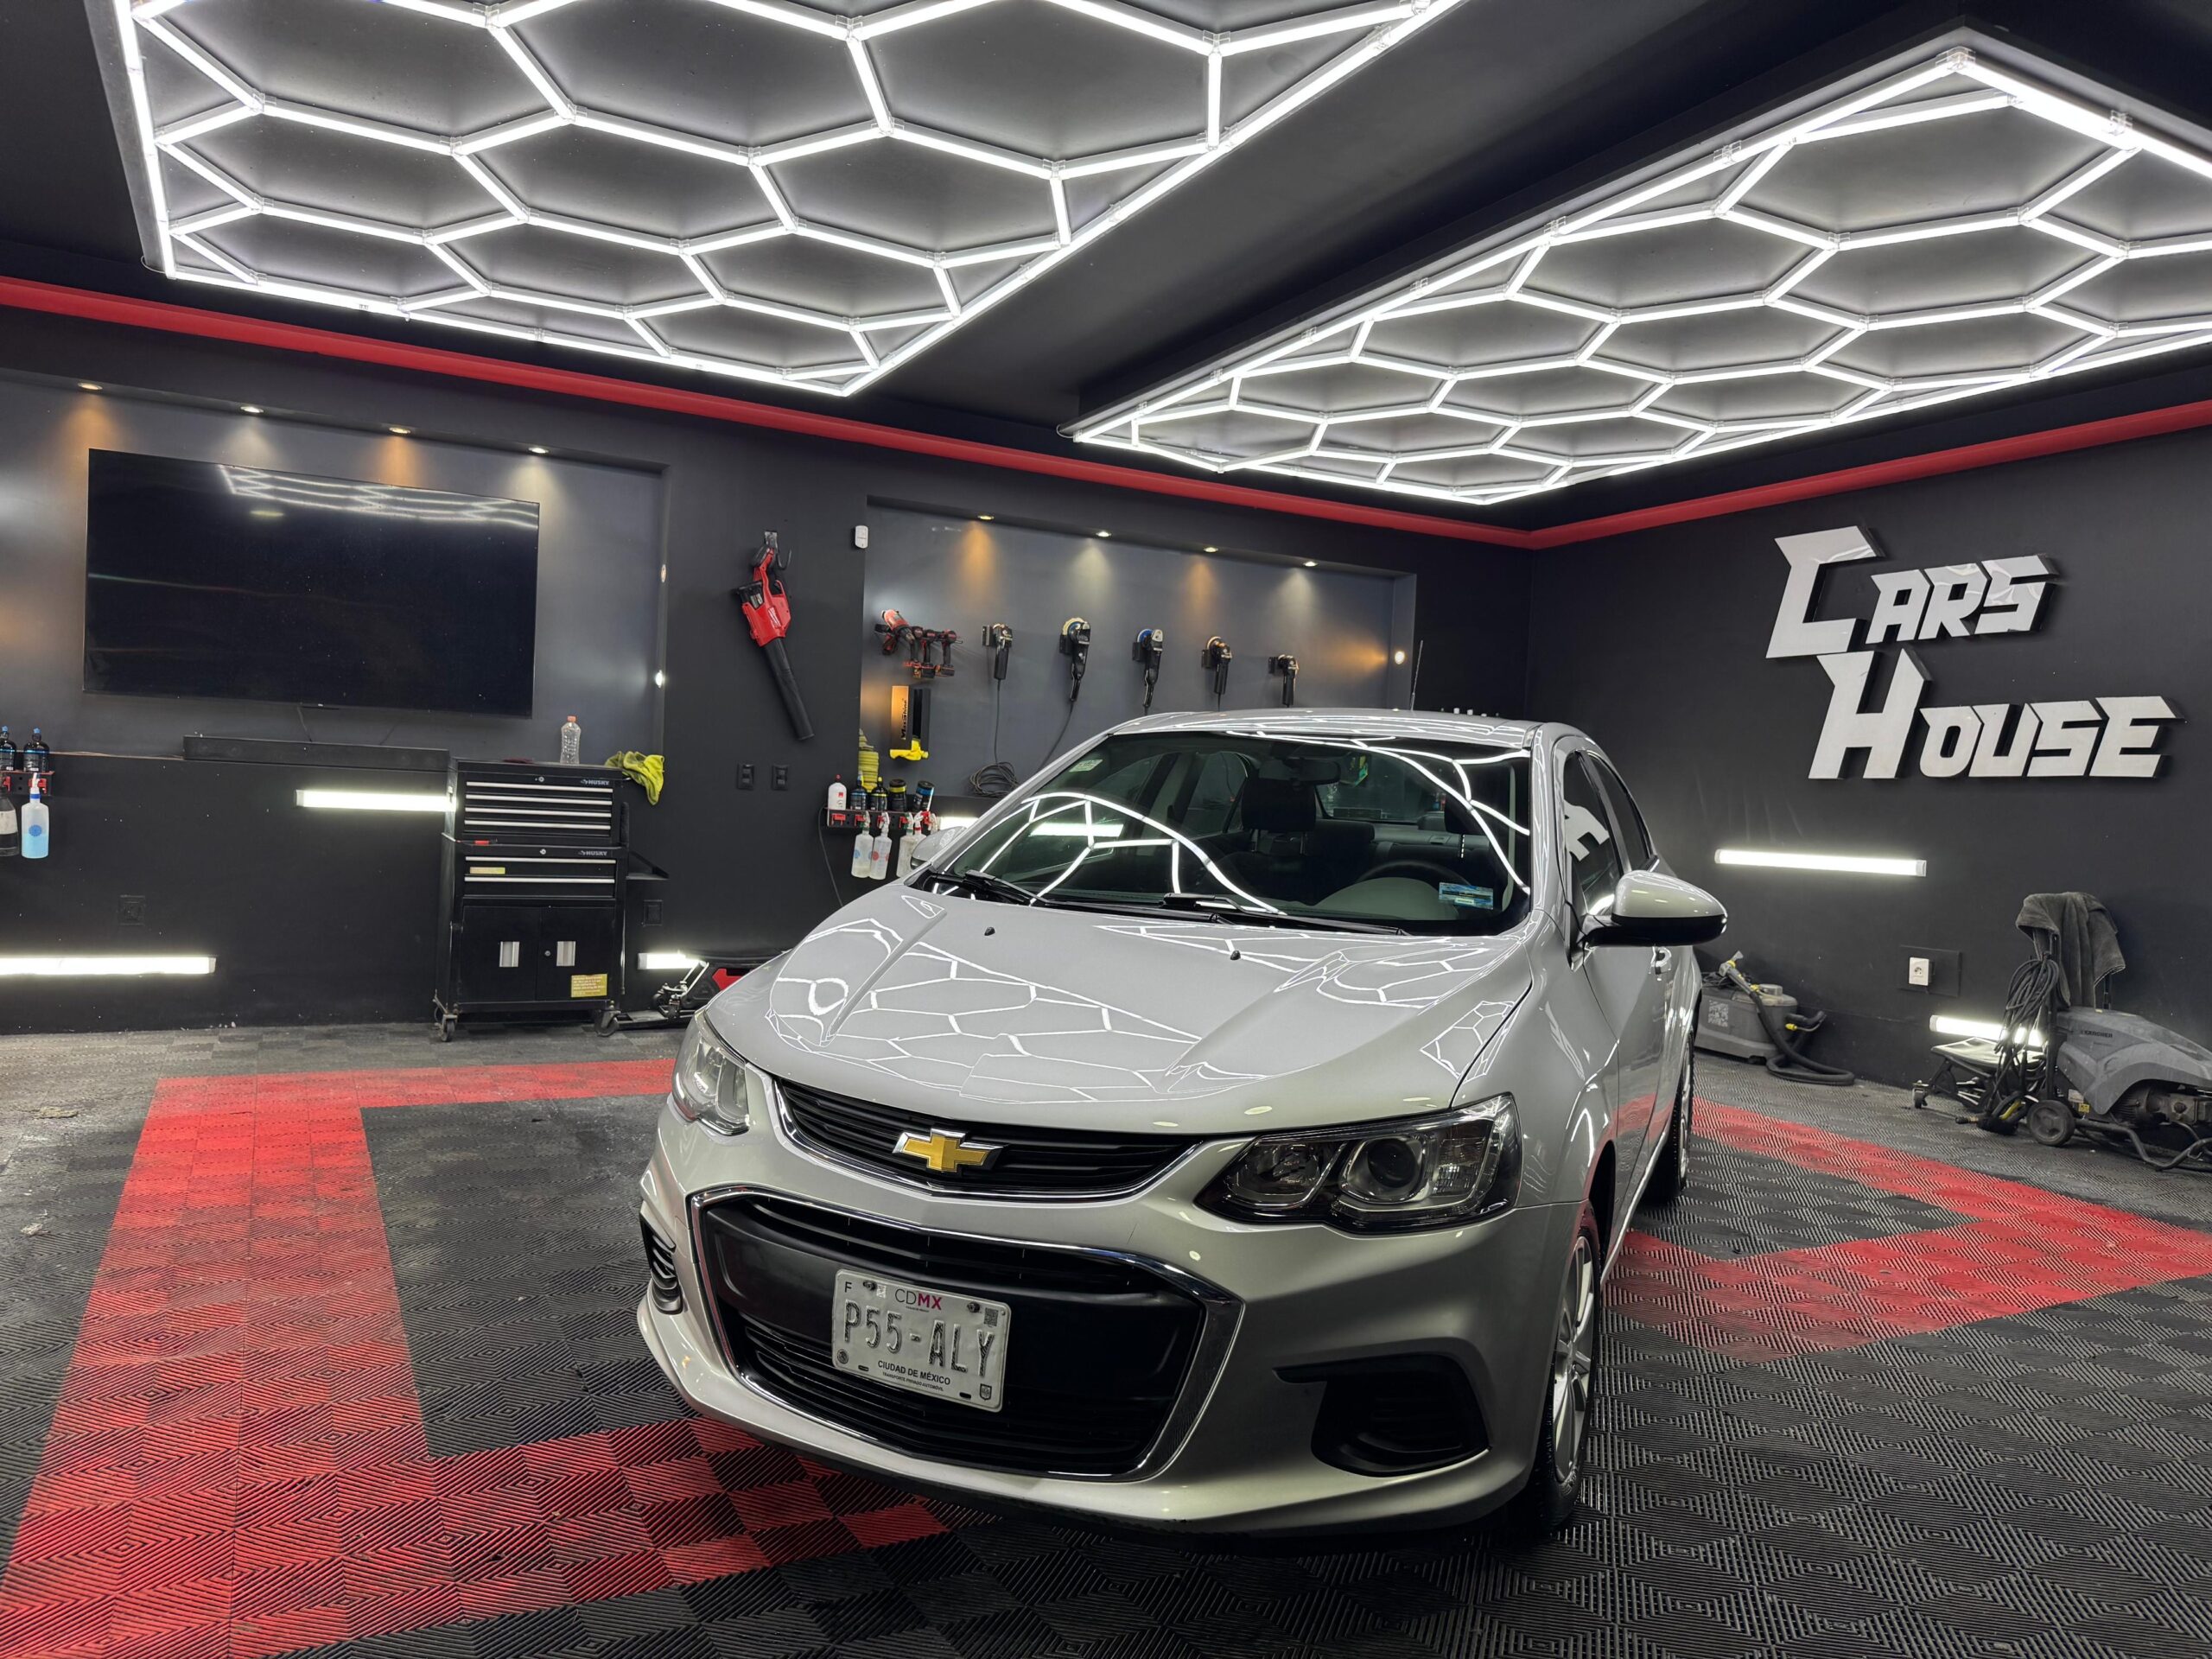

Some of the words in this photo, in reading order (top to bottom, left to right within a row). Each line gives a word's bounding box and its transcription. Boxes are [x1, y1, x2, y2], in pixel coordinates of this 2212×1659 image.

[1766, 526, 2053, 658] CARS
[1808, 648, 2178, 779] HOUSE
[844, 1281, 853, 1293] F
[894, 1288, 943, 1311] CDMX
[878, 1360, 906, 1374] CIUDAD
[907, 1368, 918, 1378] DE
[919, 1370, 951, 1385] MÉXICO
